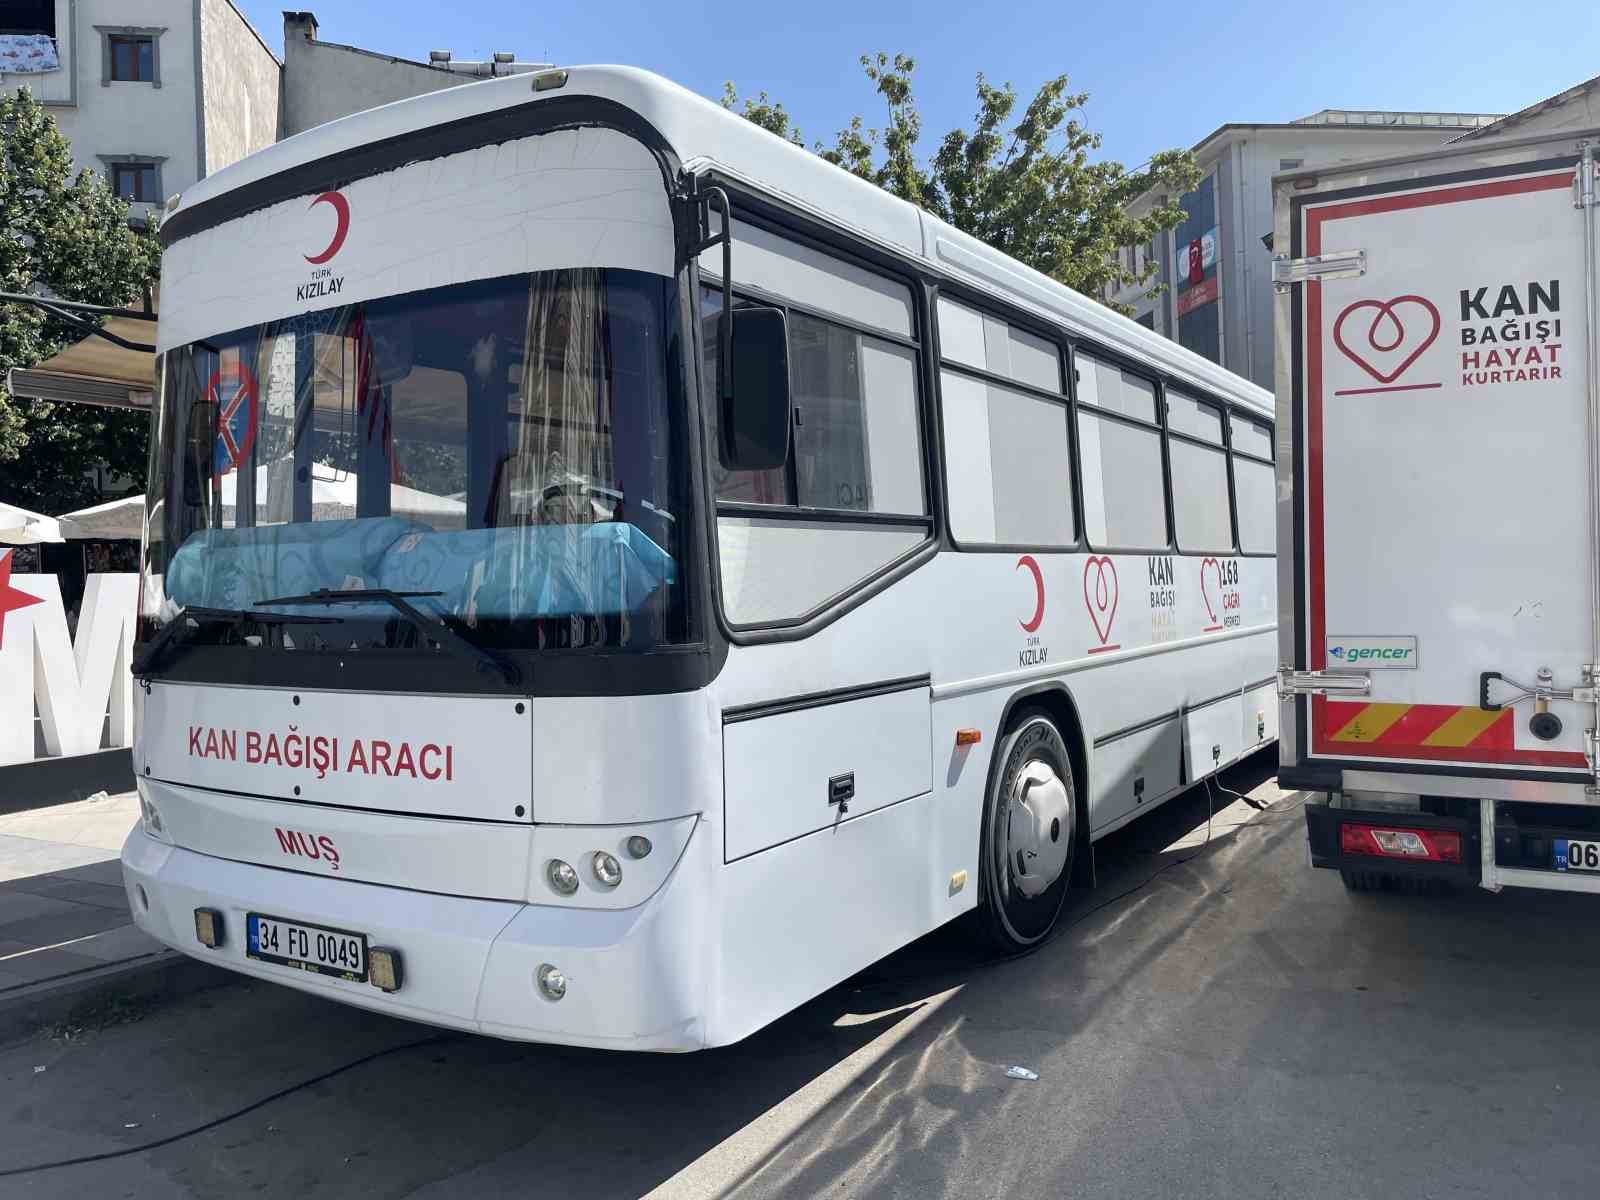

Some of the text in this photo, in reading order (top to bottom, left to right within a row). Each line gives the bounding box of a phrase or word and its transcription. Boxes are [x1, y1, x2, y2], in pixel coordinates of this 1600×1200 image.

[296, 276, 345, 302] KIZILAY
[1459, 279, 1560, 321] KAN
[1461, 318, 1561, 346] BAĞIŞI
[1462, 344, 1562, 370] HAYAT
[1462, 366, 1562, 386] KURTARIR
[1148, 557, 1174, 586] KAN
[1221, 559, 1239, 586] 168
[1019, 647, 1047, 667] KIZILAY
[1347, 647, 1412, 663] gencer
[188, 724, 453, 781] KAN BAĞIŞI ARACI
[274, 827, 340, 870] MUŞ
[1556, 842, 1599, 868] TR 06
[260, 922, 279, 953] 34
[288, 927, 309, 958] FD
[316, 933, 359, 969] 0049
